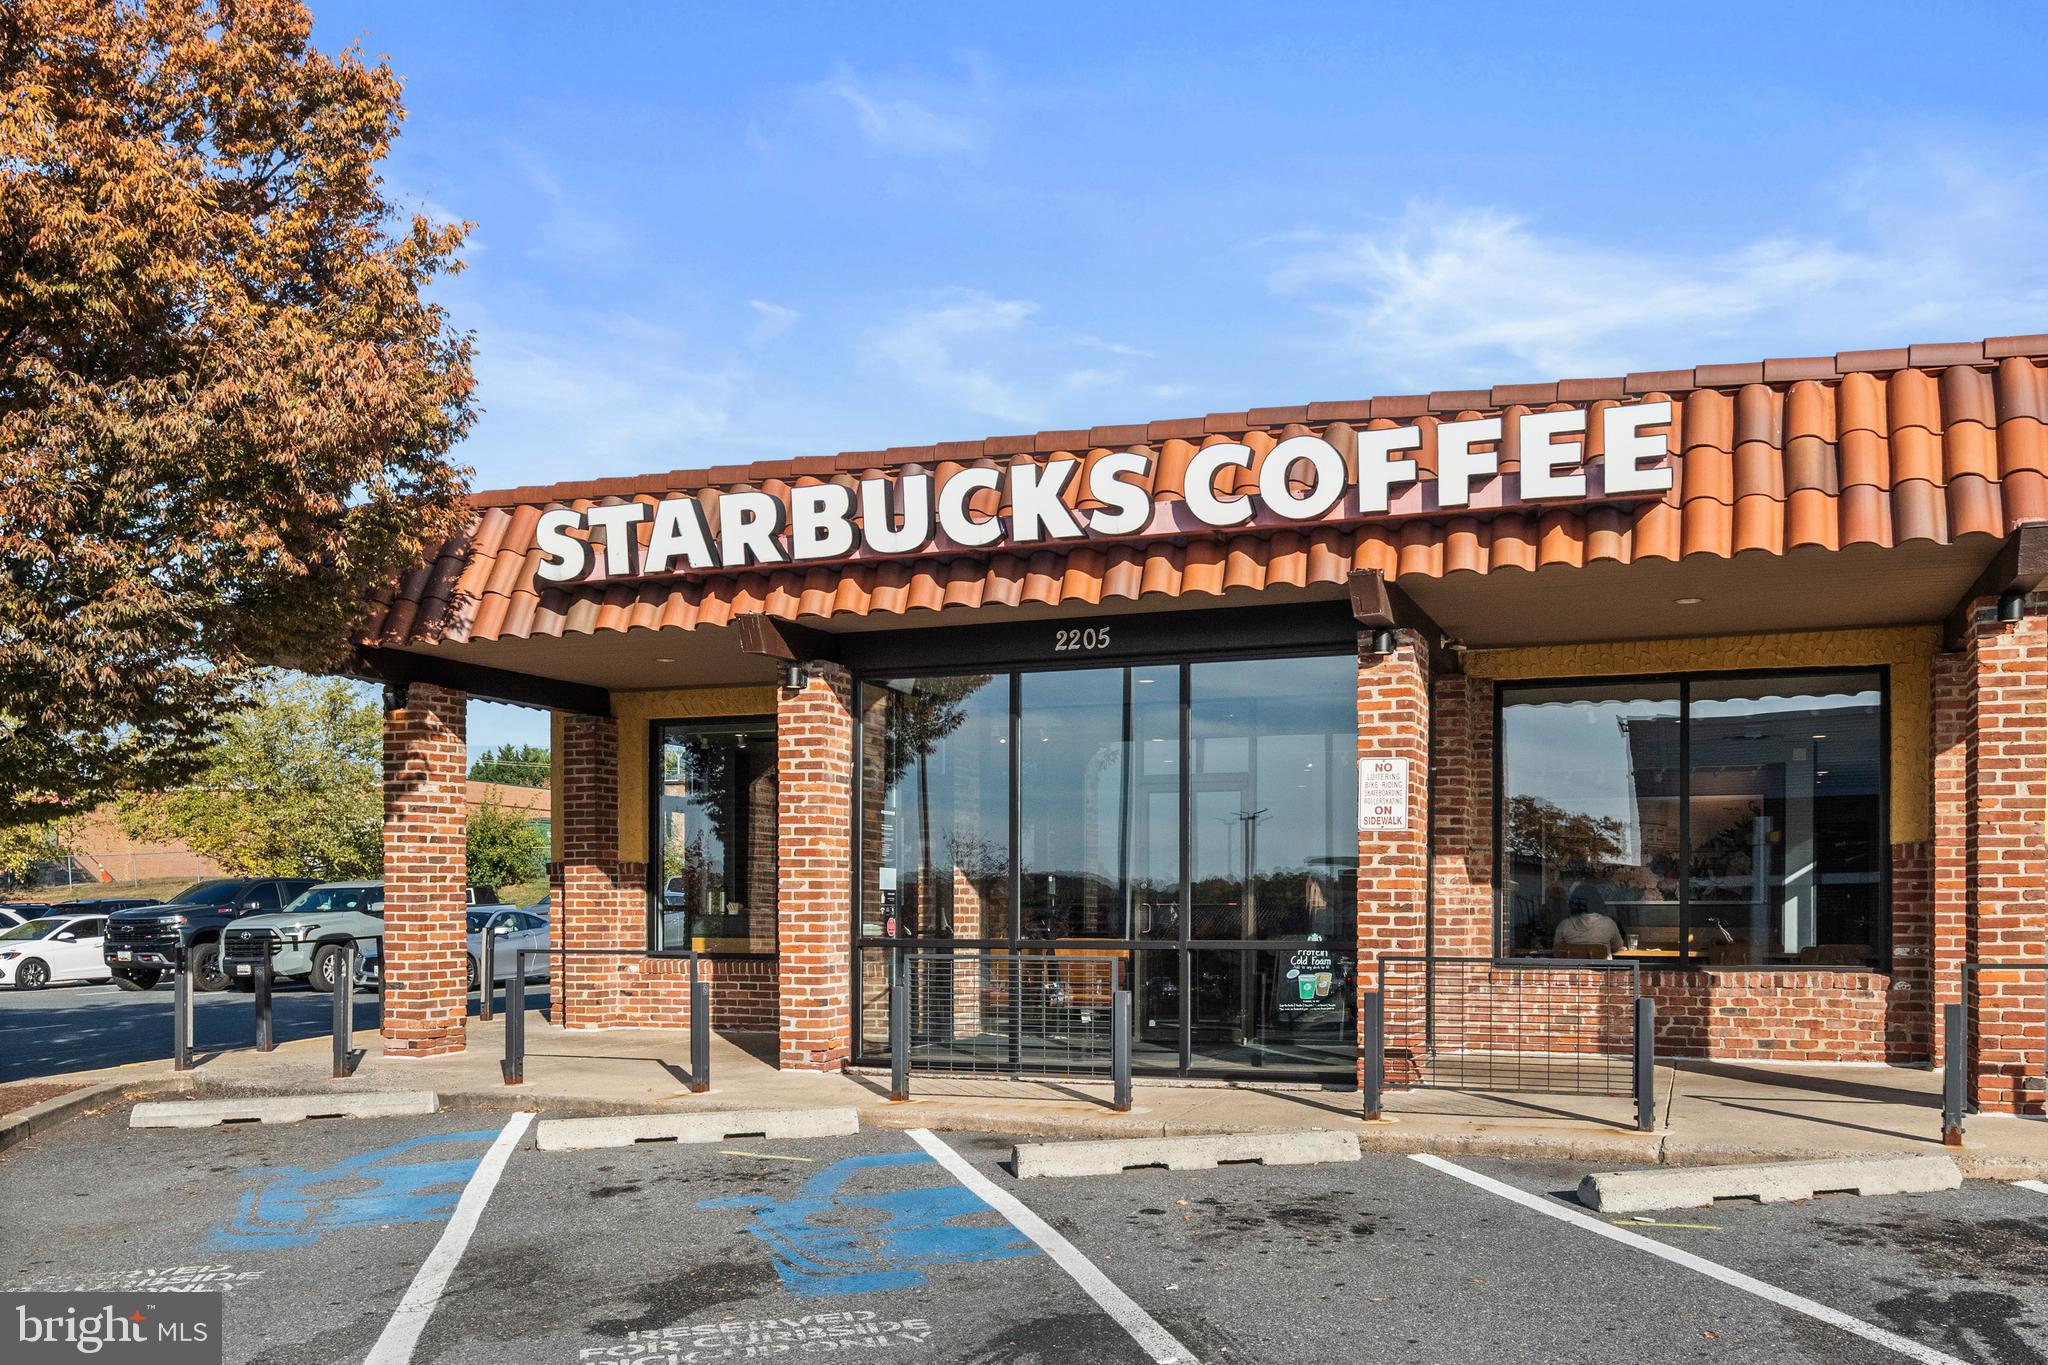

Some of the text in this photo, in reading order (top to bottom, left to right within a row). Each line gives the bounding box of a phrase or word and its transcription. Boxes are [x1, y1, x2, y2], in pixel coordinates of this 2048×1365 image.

[536, 401, 1673, 581] STARBUCKS COFFEE
[1055, 627, 1110, 651] 2205
[1375, 763, 1393, 772] NO
[1363, 816, 1403, 825] SIDEWALK
[1374, 806, 1393, 815] ON
[1290, 955, 1332, 966] Cold Foam
[628, 1310, 876, 1342] RESERVED
[579, 1318, 933, 1360] FOR CURBSIDE
[800, 1330, 932, 1351] ONLY
